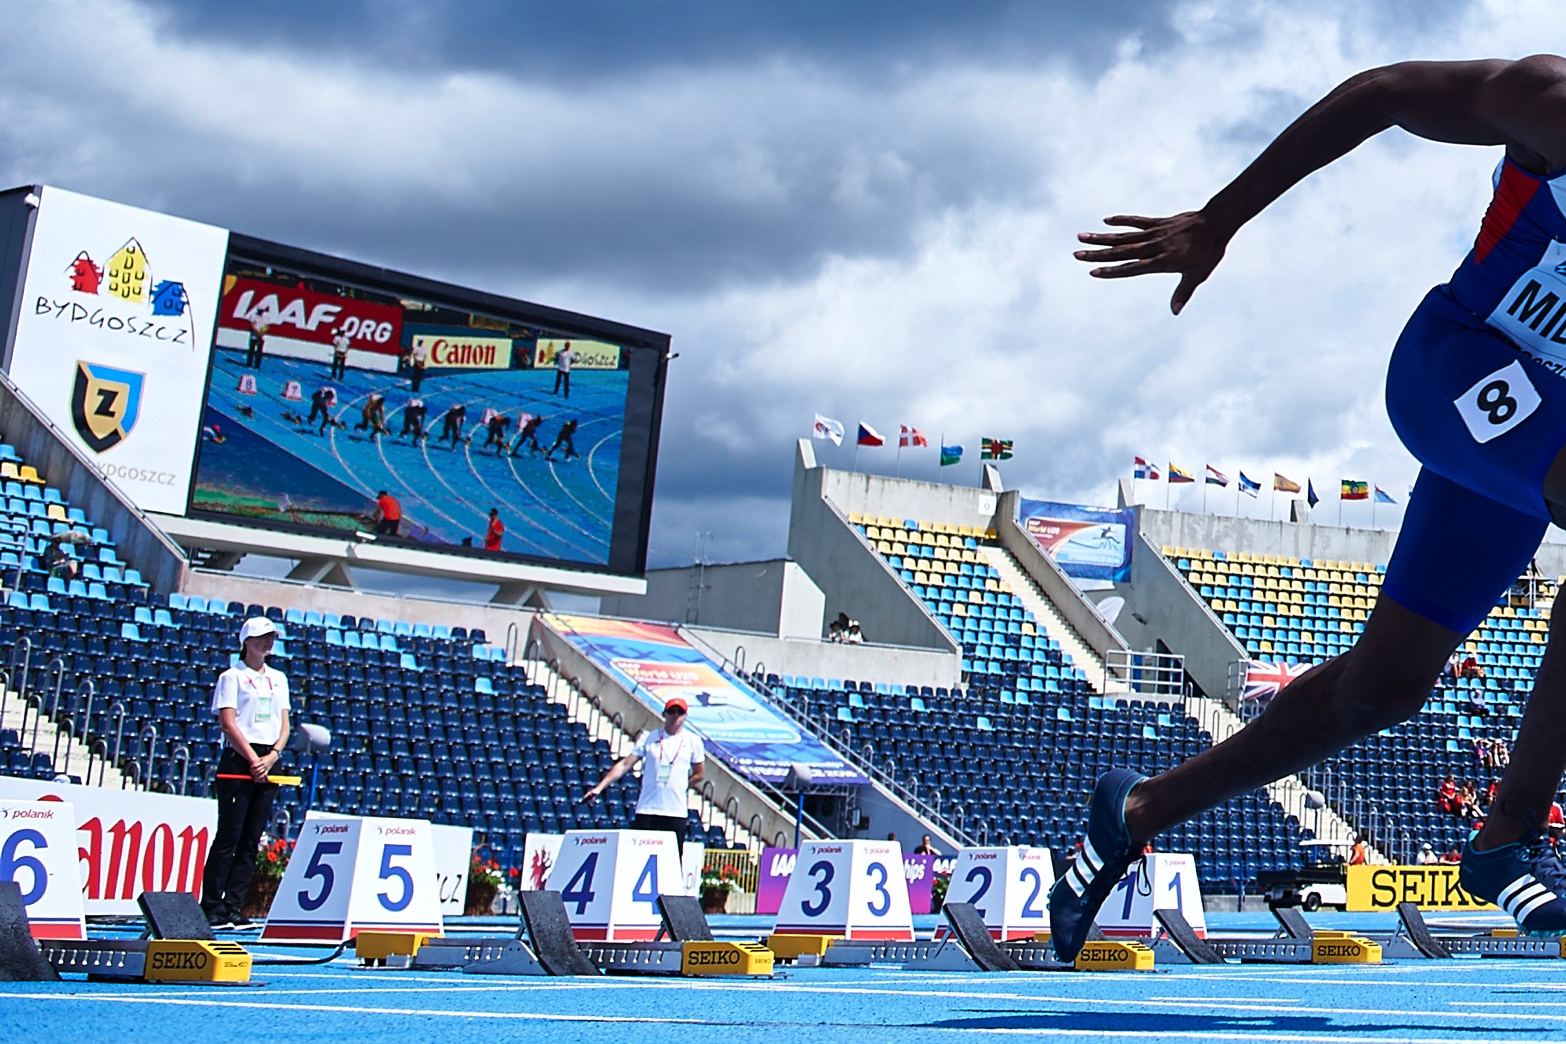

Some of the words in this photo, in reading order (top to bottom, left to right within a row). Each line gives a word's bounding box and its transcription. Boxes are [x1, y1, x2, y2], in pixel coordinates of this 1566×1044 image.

[35, 296, 187, 344] BYDGOSZCZ
[431, 338, 496, 366] Canon
[94, 388, 119, 418] Z
[1477, 379, 1517, 425] 8
[96, 462, 176, 486] YDGOSZCZ
[12, 808, 55, 820] polanik
[320, 824, 350, 835] polanik
[385, 825, 417, 836] polanik
[0, 828, 49, 906] 6
[77, 817, 208, 905] anon
[297, 841, 343, 912] 5
[376, 843, 415, 913] 5
[561, 851, 600, 915] 4
[770, 853, 797, 877] IAA
[631, 854, 660, 915] 4
[801, 860, 835, 918] 3
[866, 861, 891, 917] 3
[965, 865, 993, 918] 2
[1019, 867, 1044, 919] 2
[1117, 871, 1138, 920] 1
[1168, 871, 1184, 915] 1
[1371, 870, 1490, 907] SEIK
[152, 952, 207, 969] SEIKO
[688, 951, 740, 965] SEIKO
[1080, 949, 1129, 962] SEIKO
[1317, 945, 1361, 956] SEIKO
